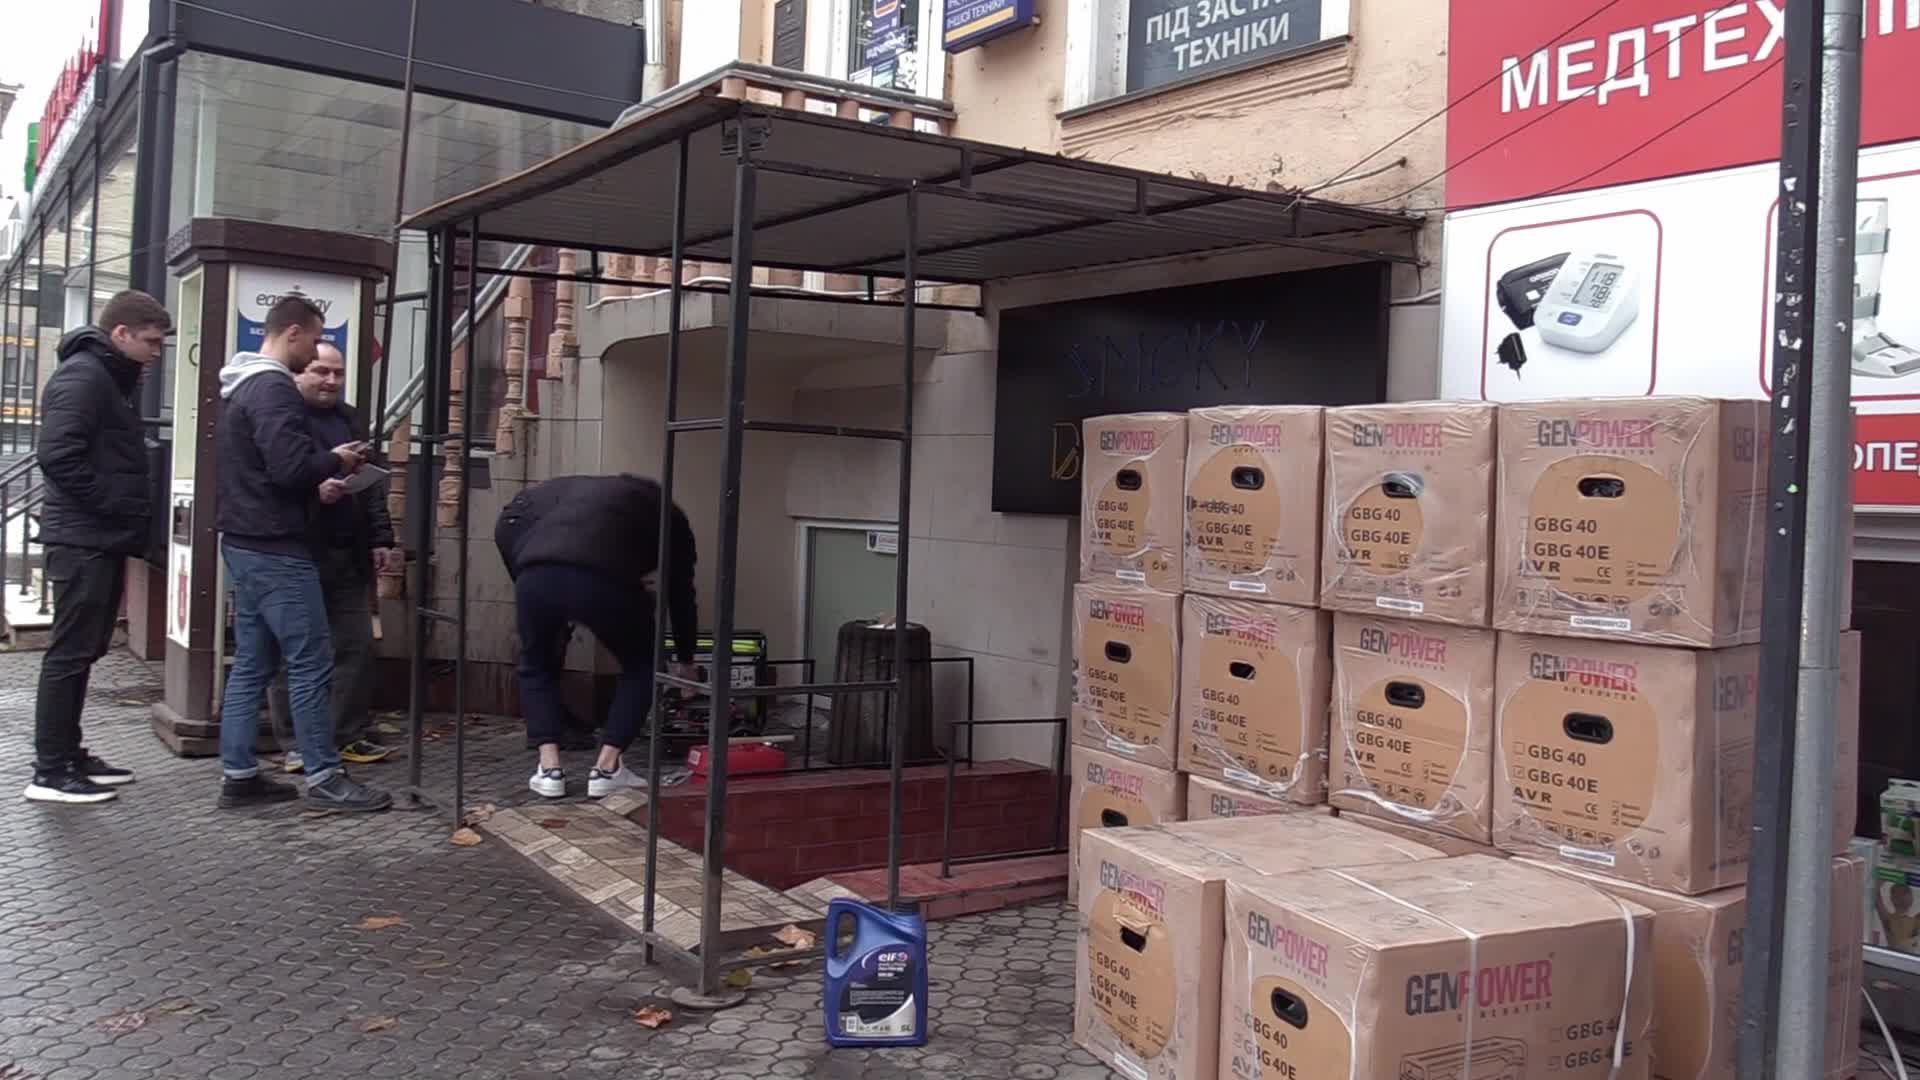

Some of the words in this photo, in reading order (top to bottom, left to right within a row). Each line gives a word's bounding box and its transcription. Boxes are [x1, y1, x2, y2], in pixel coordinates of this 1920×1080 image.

[1146, 6, 1190, 44] ПІД
[1196, 0, 1284, 28] ЗАС
[1173, 12, 1290, 71] ТЕХНІКИ
[1101, 431, 1153, 450] GENPOWER
[1210, 424, 1280, 447] GENPOWER
[1353, 424, 1442, 447] GENPOWER
[1537, 419, 1656, 448] GENPOWER
[1098, 500, 1117, 511] GBG
[1118, 502, 1128, 512] 40
[1231, 504, 1245, 515] 40
[1352, 507, 1381, 520] GBG
[1384, 508, 1400, 521] 40
[1097, 519, 1117, 529] GBG
[1118, 519, 1135, 531] 40E
[1206, 522, 1229, 535] GBG
[1231, 524, 1252, 537] 40E
[1534, 517, 1572, 533] GBG
[1576, 519, 1597, 533] 40
[1198, 535, 1224, 546] AVR
[1351, 529, 1381, 543] GBG
[1384, 531, 1410, 545] 40E
[1533, 542, 1572, 558] GBG
[1576, 545, 1609, 560] 40E
[1519, 559, 1560, 573] AVR
[1090, 600, 1144, 627] GENPOWER
[1360, 627, 1447, 664] GENPOWER
[1530, 652, 1639, 693] GENPOWER
[1202, 688, 1225, 703] GBG
[1226, 694, 1240, 705] 40
[1201, 708, 1225, 723] GBG
[1226, 713, 1247, 728] 40E
[1356, 710, 1384, 727] GBG
[1387, 716, 1402, 729] 40
[1356, 731, 1384, 748] GBG
[1386, 738, 1411, 754] 40E
[1528, 744, 1563, 763] GBG
[1567, 751, 1586, 766] 40
[1088, 762, 1144, 795] GENPOWER
[1528, 768, 1563, 786] GBG
[1567, 775, 1598, 793] 40E
[1513, 786, 1552, 803] AVR
[1248, 911, 1328, 978] GENPOWER
[1097, 951, 1117, 974] GBG
[1119, 966, 1130, 980] 40
[1097, 975, 1118, 997] GBG
[1119, 989, 1137, 1010] 40E
[1405, 959, 1552, 1016] GENPOWER
[1566, 1020, 1603, 1041] GBG
[1605, 1016, 1622, 1034] 4
[1273, 1031, 1287, 1049] 40
[1273, 1058, 1297, 1080] 40E
[1565, 1048, 1601, 1069] GBG
